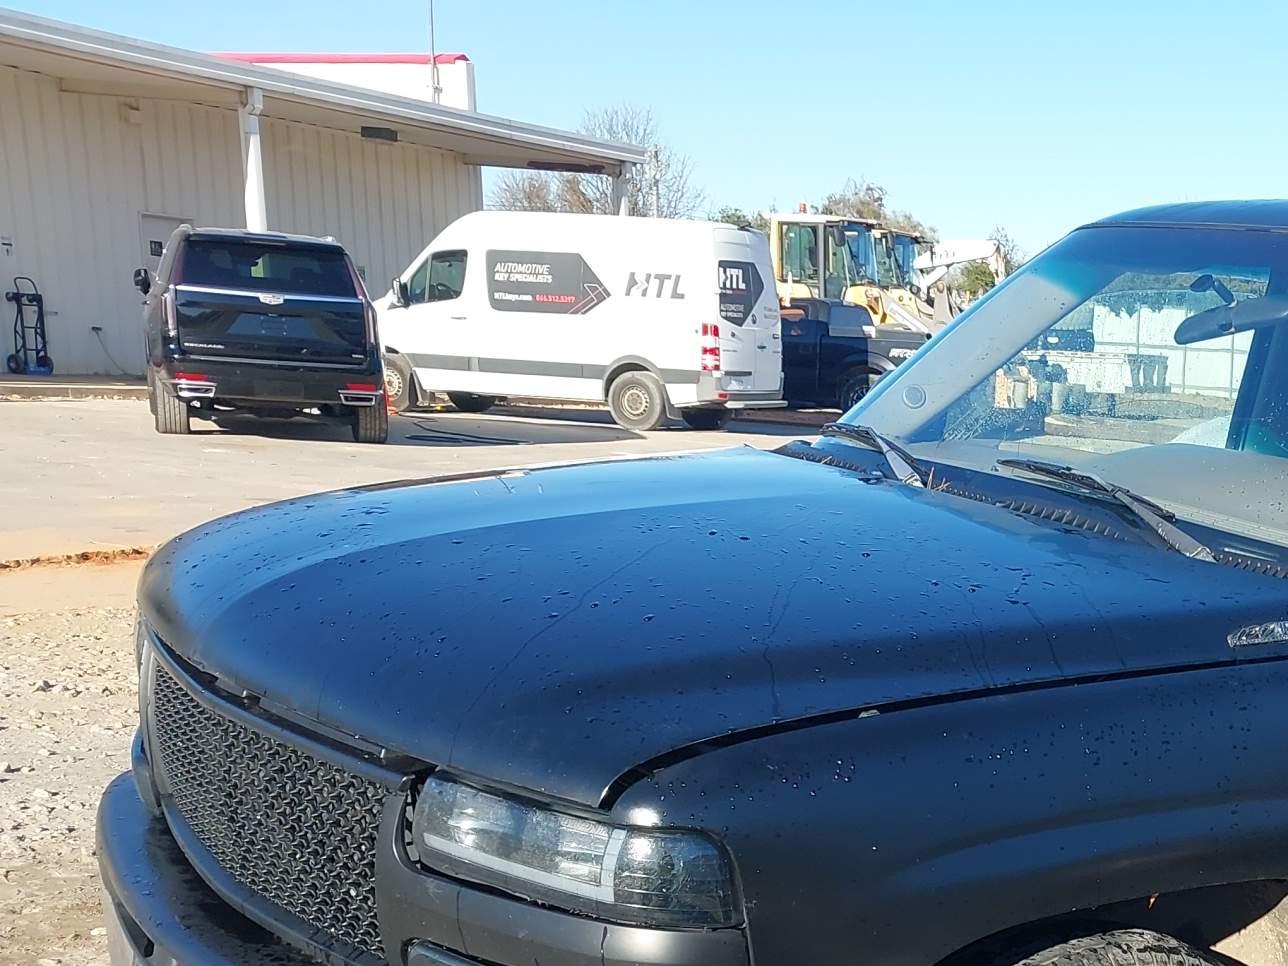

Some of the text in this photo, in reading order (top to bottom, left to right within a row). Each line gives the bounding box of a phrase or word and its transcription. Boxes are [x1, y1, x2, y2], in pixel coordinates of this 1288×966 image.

[494, 262, 551, 274] AUTOMOTIVE
[509, 274, 553, 283] SPECIALISTS
[625, 272, 685, 299] HTL
[719, 267, 746, 289] HTL
